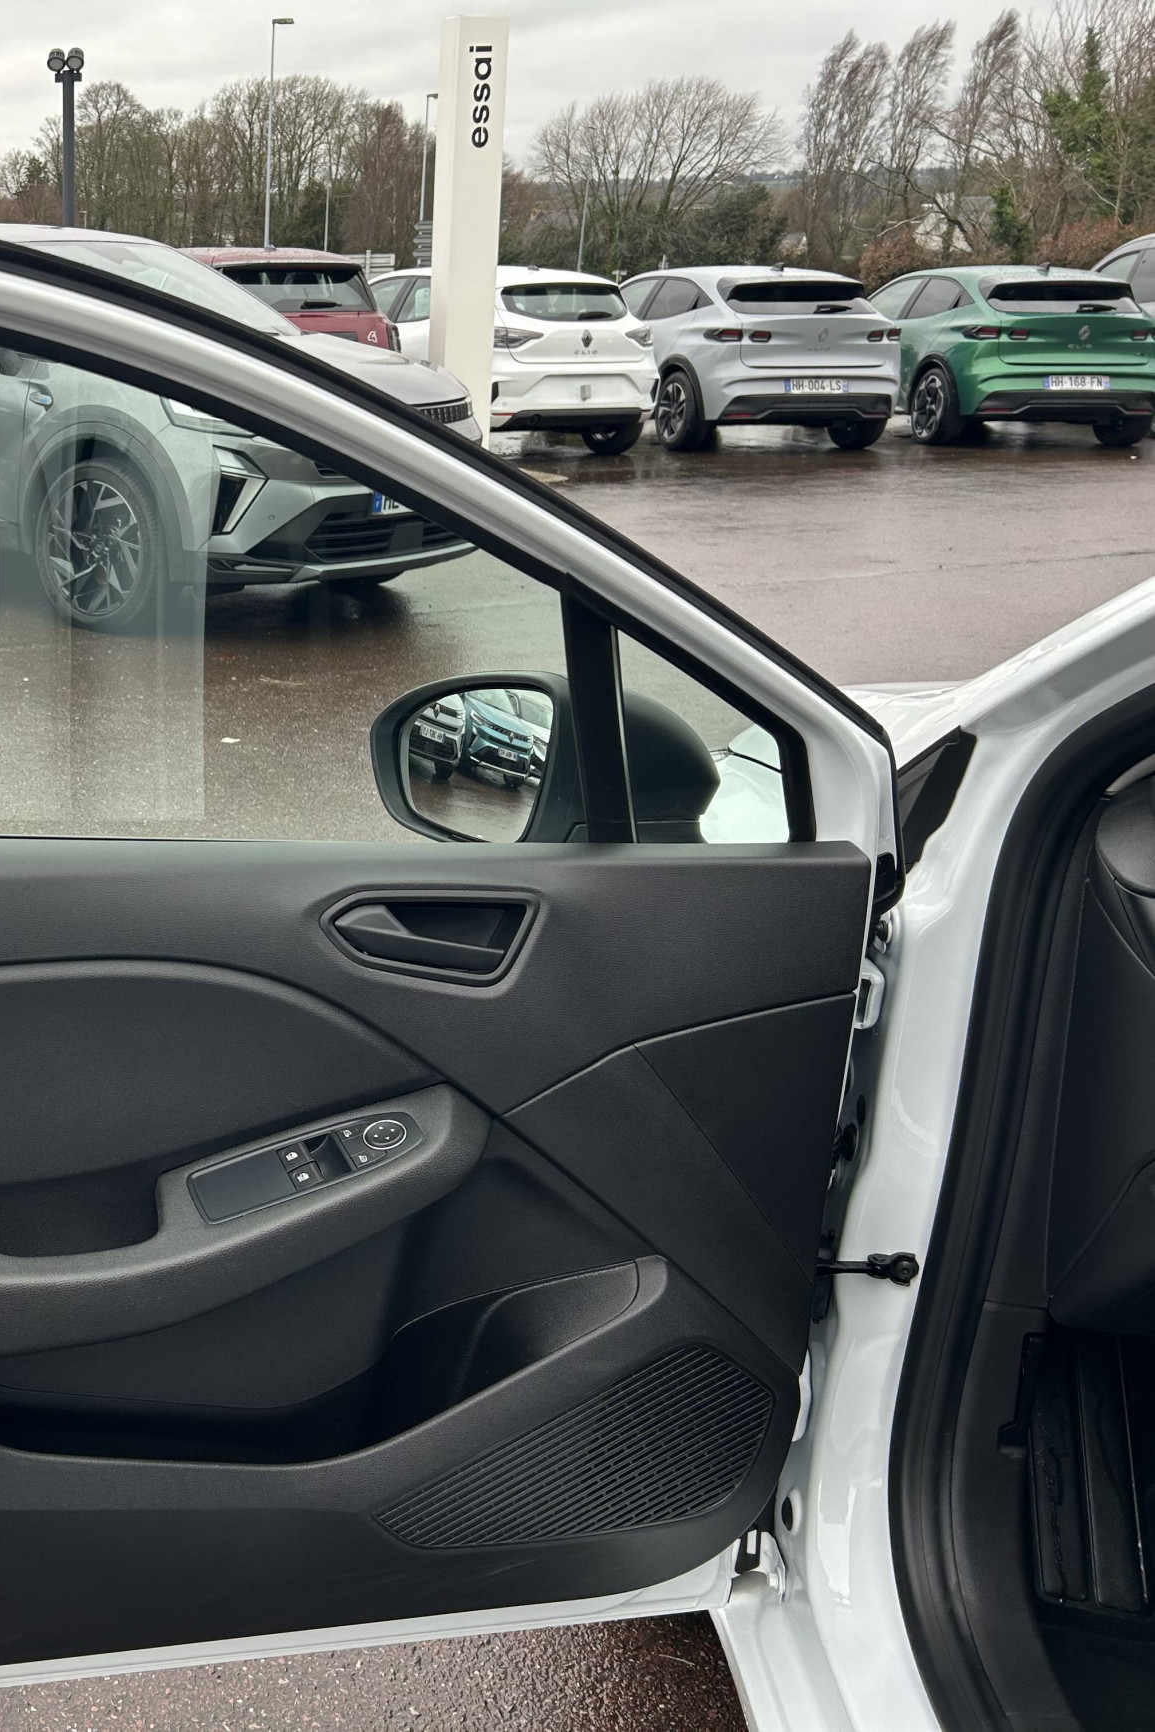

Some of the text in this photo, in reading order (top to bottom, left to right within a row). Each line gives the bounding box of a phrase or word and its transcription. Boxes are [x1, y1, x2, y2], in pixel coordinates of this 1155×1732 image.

[469, 45, 493, 148] essai
[792, 380, 841, 391] HH-004-LS
[1050, 376, 1103, 387] HH-168-FN
